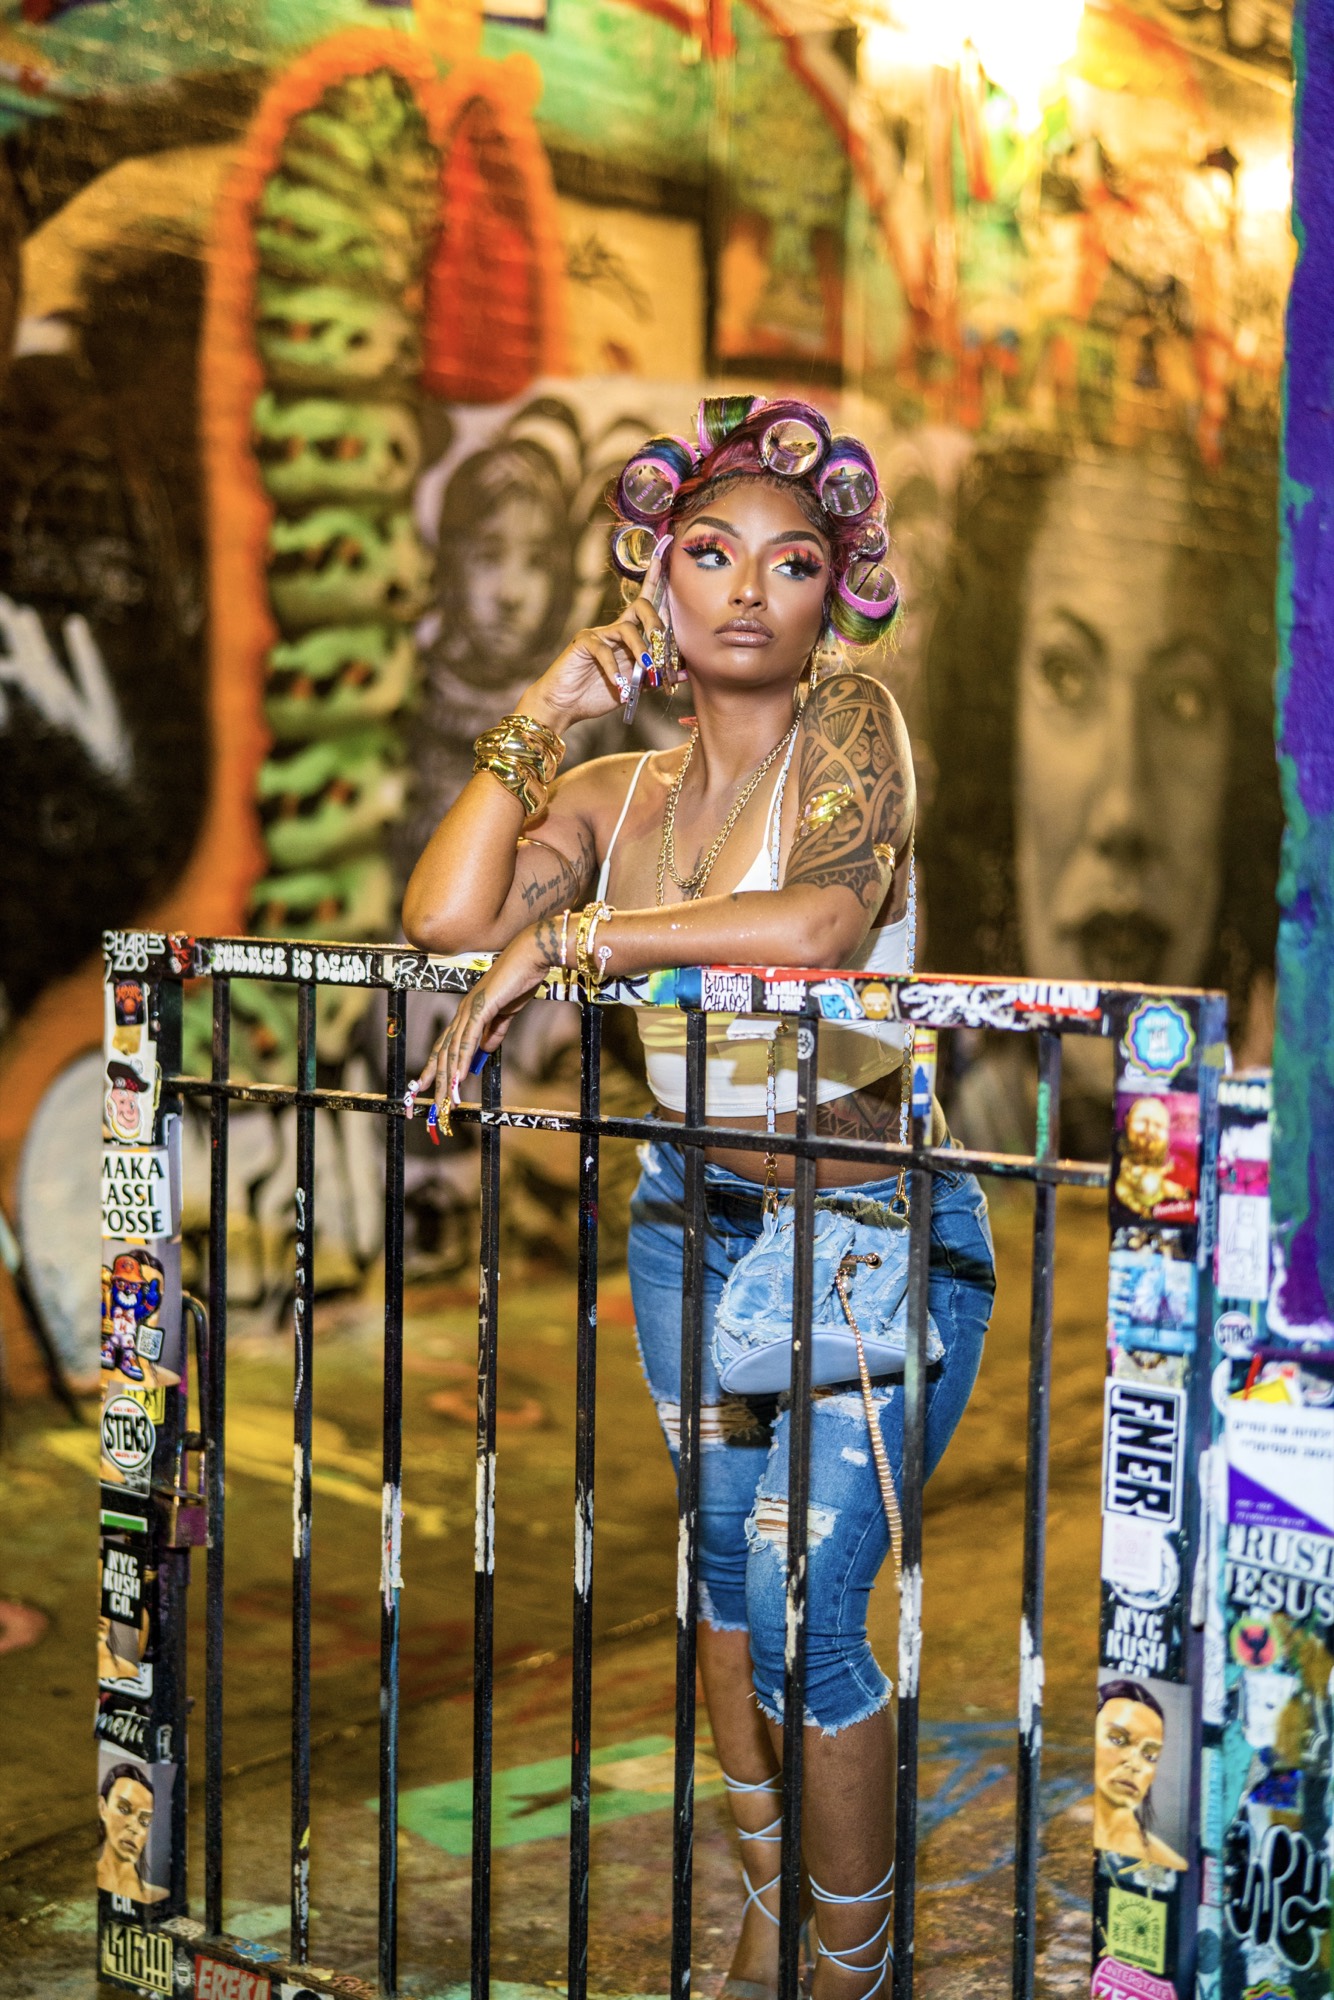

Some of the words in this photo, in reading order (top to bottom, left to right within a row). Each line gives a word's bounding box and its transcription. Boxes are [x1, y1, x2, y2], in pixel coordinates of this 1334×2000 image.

[102, 930, 167, 955] CHARLES
[113, 951, 149, 973] ZOO
[212, 942, 288, 976] SUMMER
[102, 1183, 155, 1207] ASSI
[106, 1549, 138, 1577] NYC
[1230, 1525, 1334, 1578] RUST
[103, 1568, 141, 1600] KUSH
[109, 1592, 135, 1618] CO.
[1114, 1605, 1163, 1642] NYC
[1106, 1629, 1167, 1672] KUSH
[1104, 1964, 1169, 2000] INTERSTATE
